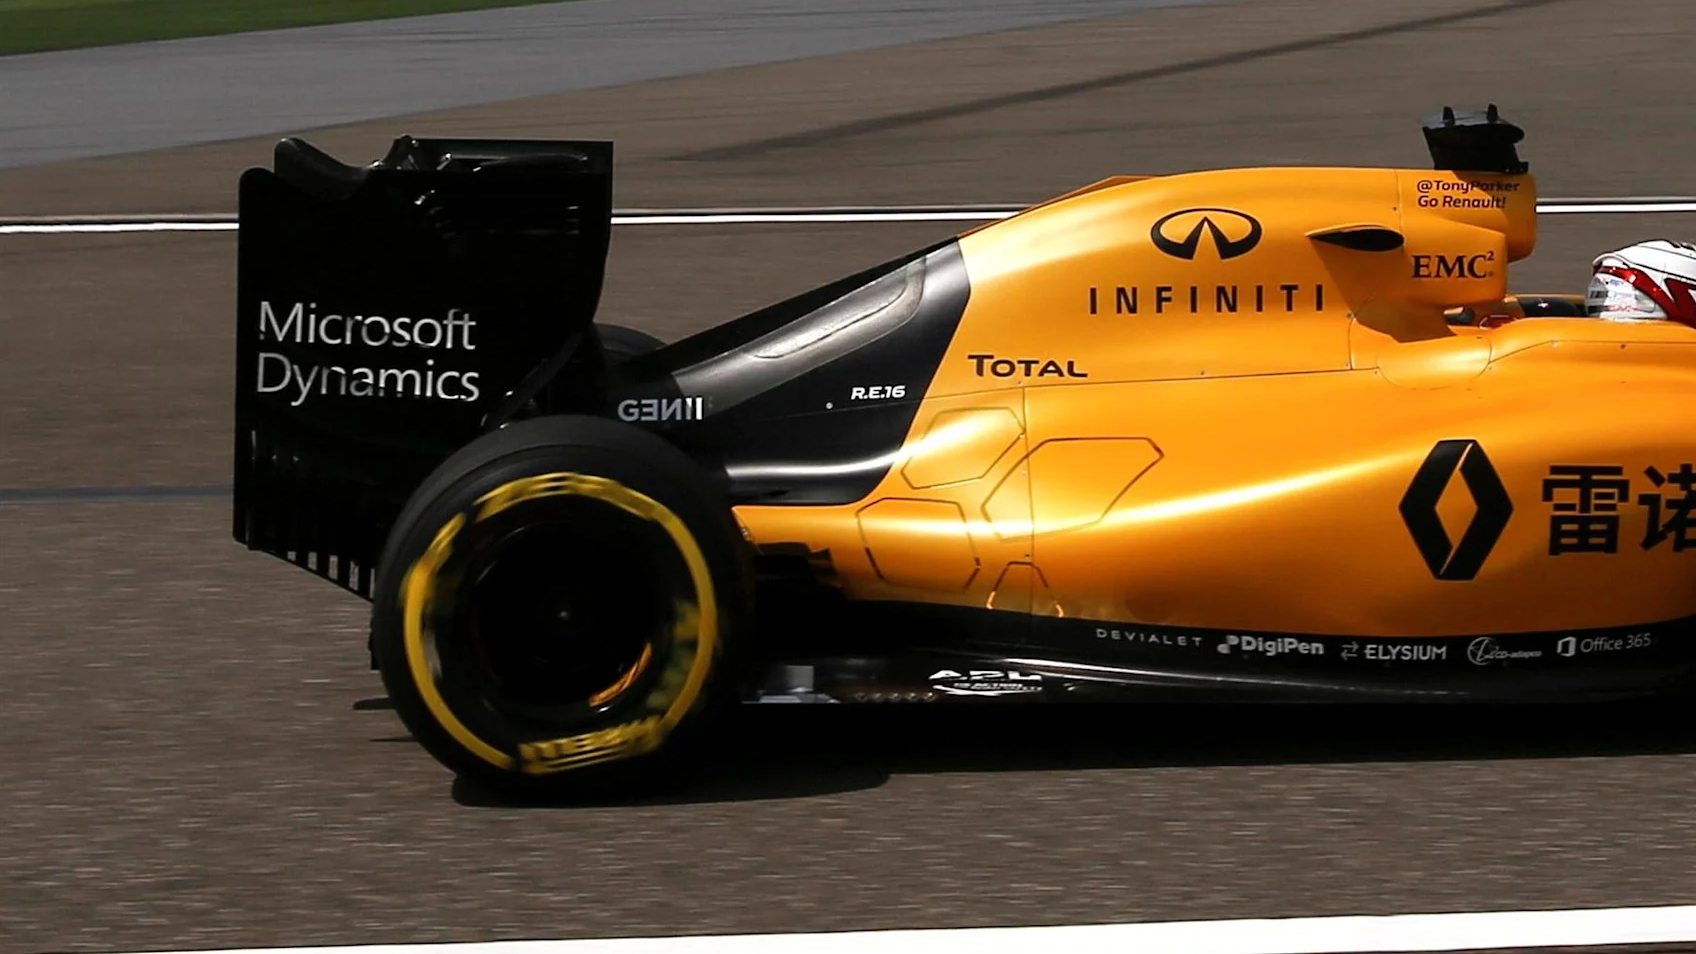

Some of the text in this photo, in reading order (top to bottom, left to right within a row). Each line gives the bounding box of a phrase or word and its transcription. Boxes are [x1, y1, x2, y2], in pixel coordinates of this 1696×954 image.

[1417, 179, 1520, 194] @TonyParker
[1418, 195, 1506, 209] Go Renault!
[1089, 284, 1323, 314] INFINITI
[258, 300, 477, 350] Microsoft
[256, 352, 480, 407] Dynamics
[850, 385, 906, 400] R.E.16
[1096, 628, 1203, 647] DEVIALET
[1241, 635, 1325, 657] DigiPen
[1579, 632, 1651, 653] Office 365
[1364, 644, 1448, 661] ELYSIUM
